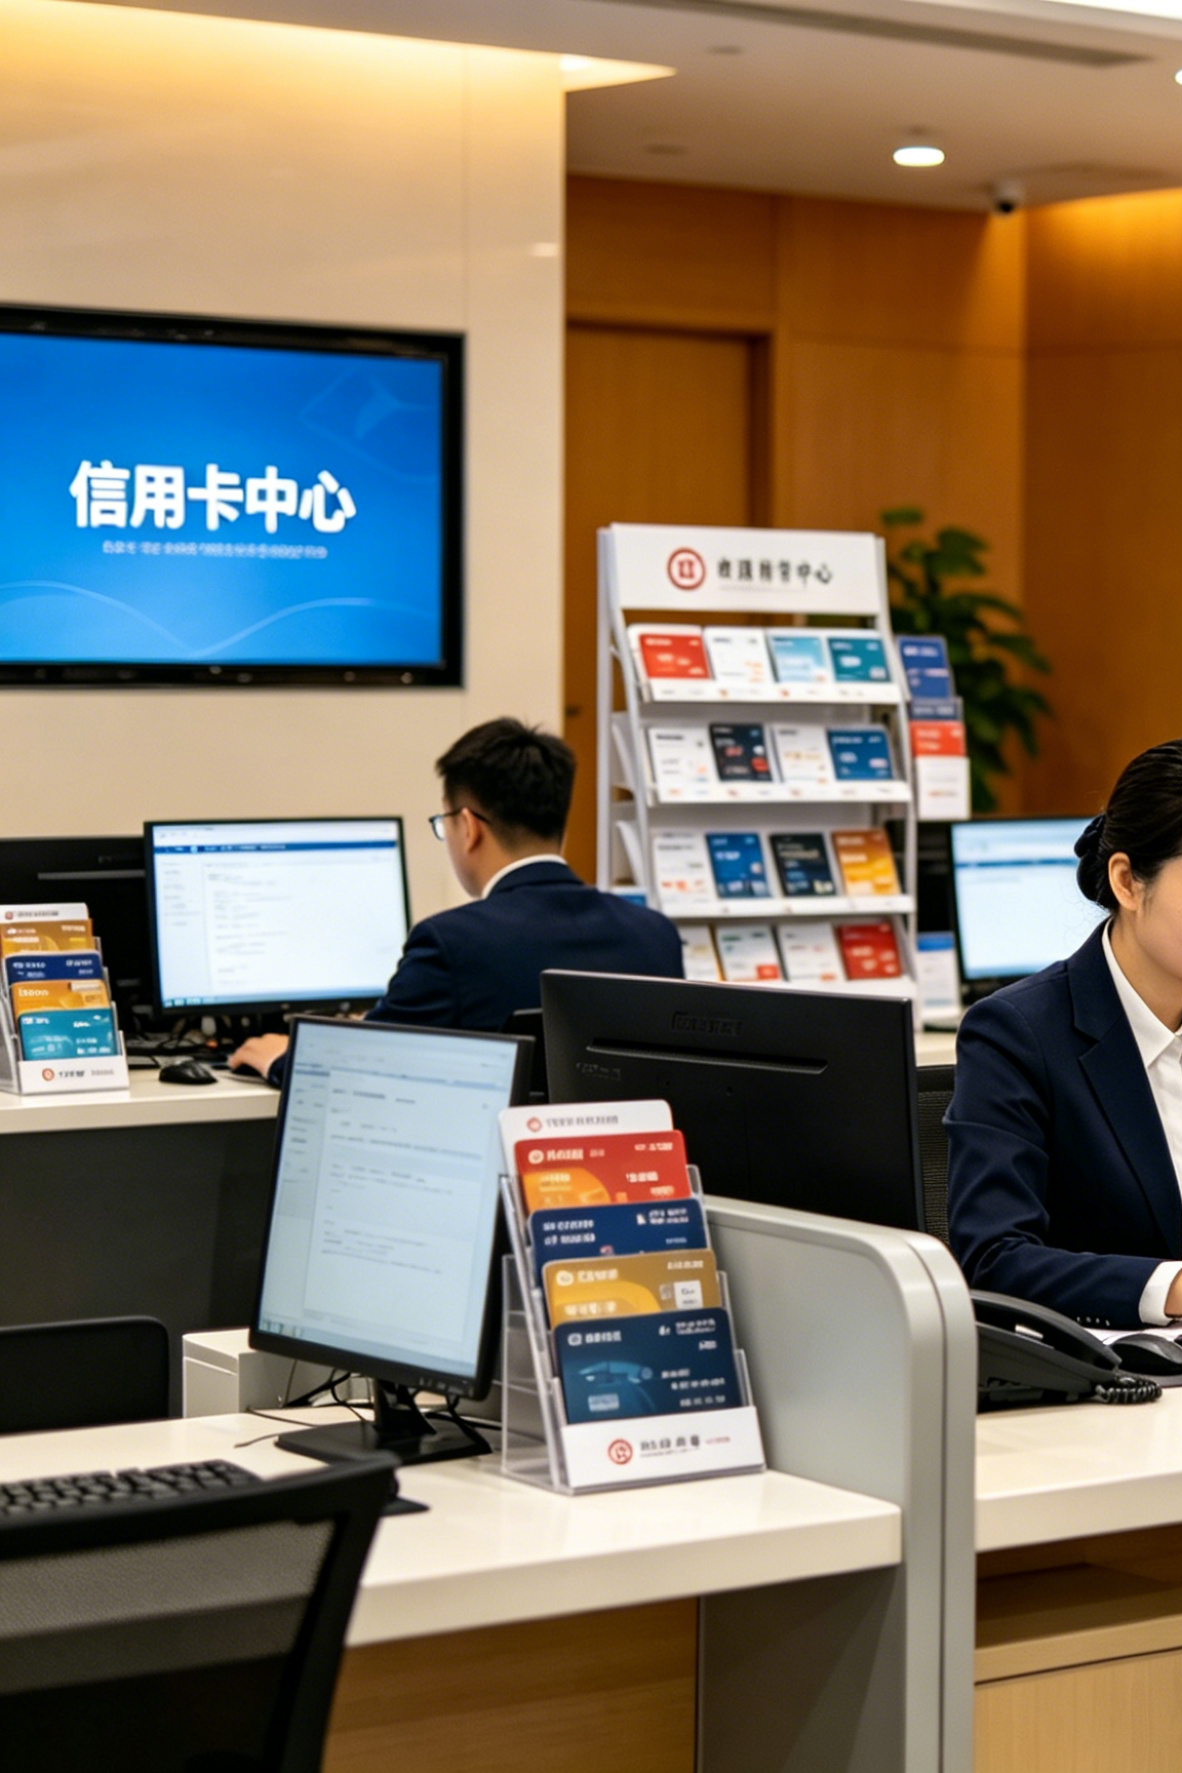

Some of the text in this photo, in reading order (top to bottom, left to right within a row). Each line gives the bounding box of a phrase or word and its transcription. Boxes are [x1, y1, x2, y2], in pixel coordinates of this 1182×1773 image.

[69, 460, 357, 533] 信用卡中心
